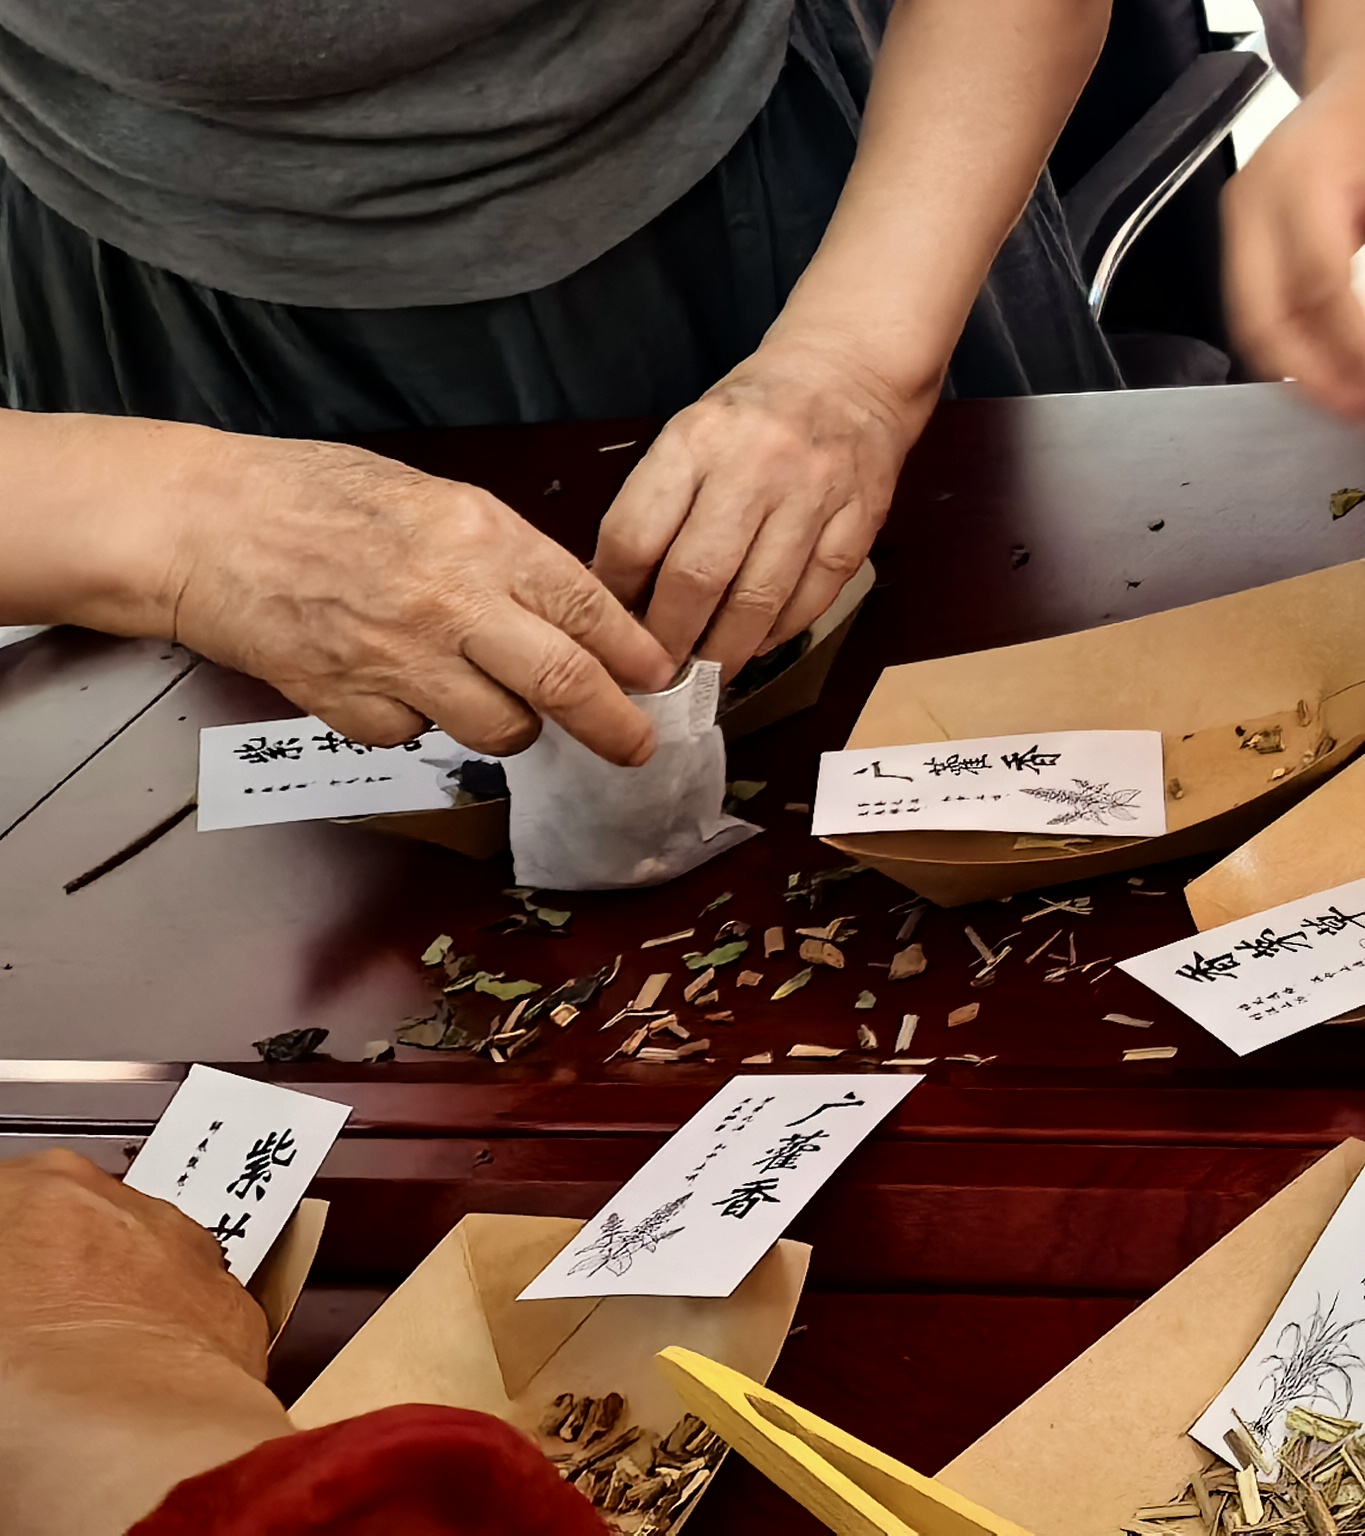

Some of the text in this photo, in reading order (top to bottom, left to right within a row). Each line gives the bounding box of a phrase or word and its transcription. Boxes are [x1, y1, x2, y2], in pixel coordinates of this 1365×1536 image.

[853, 745, 1061, 783] 广藿香
[711, 1091, 866, 1219] 广藿香
